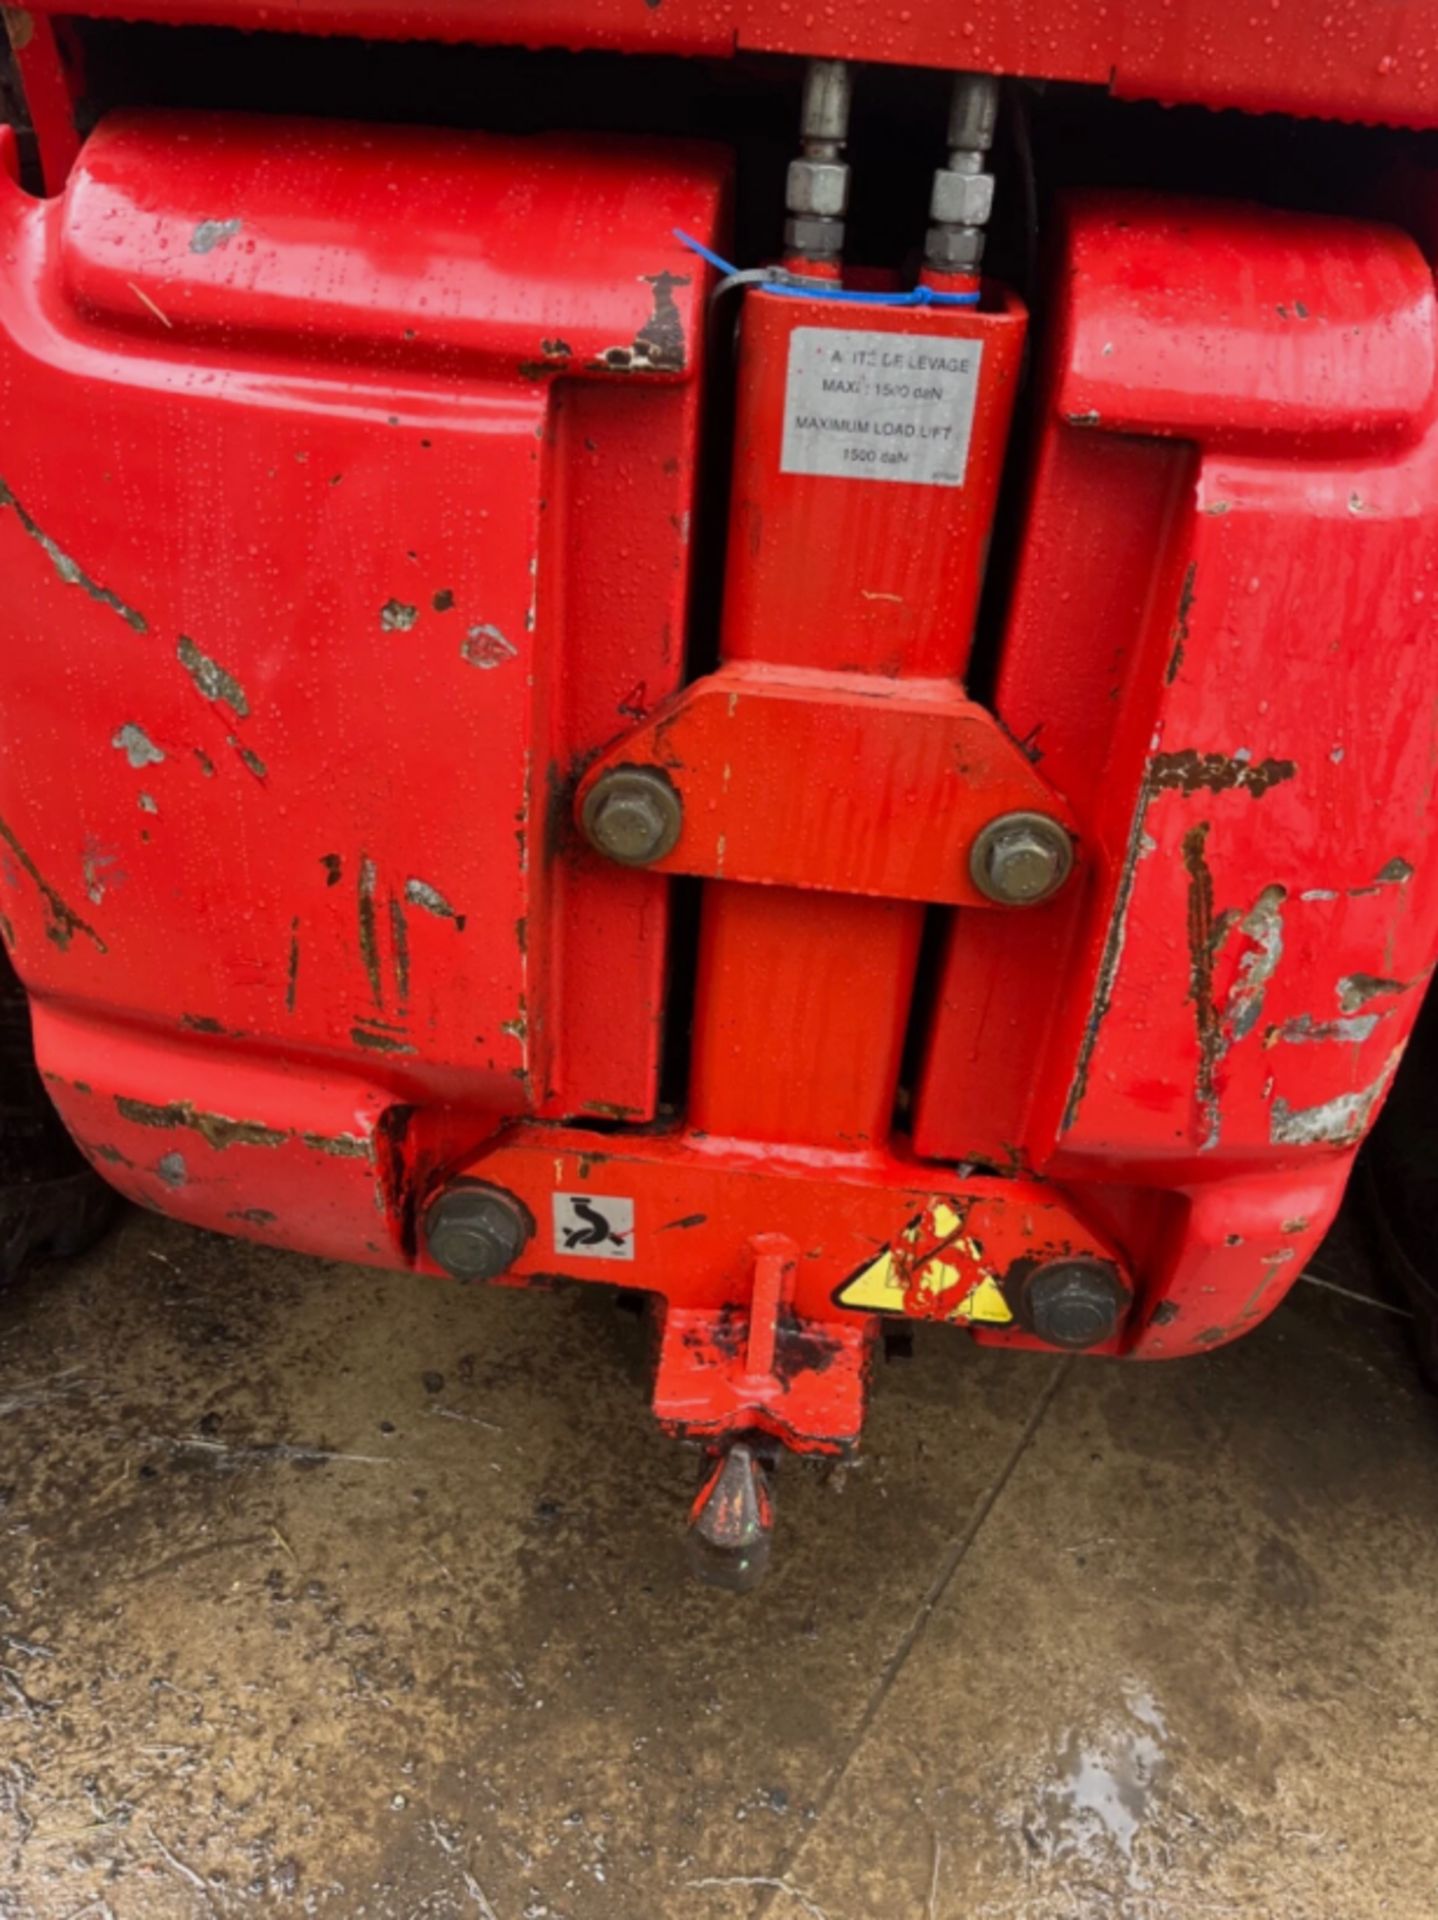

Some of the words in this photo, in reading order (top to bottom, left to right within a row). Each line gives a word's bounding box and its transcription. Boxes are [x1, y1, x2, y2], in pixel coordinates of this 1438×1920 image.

[908, 353, 969, 374] LEVAGE
[795, 415, 869, 434] MAXIMUM
[874, 421, 915, 438] LOAD
[920, 425, 953, 441] LIFT
[843, 447, 877, 463] 1500
